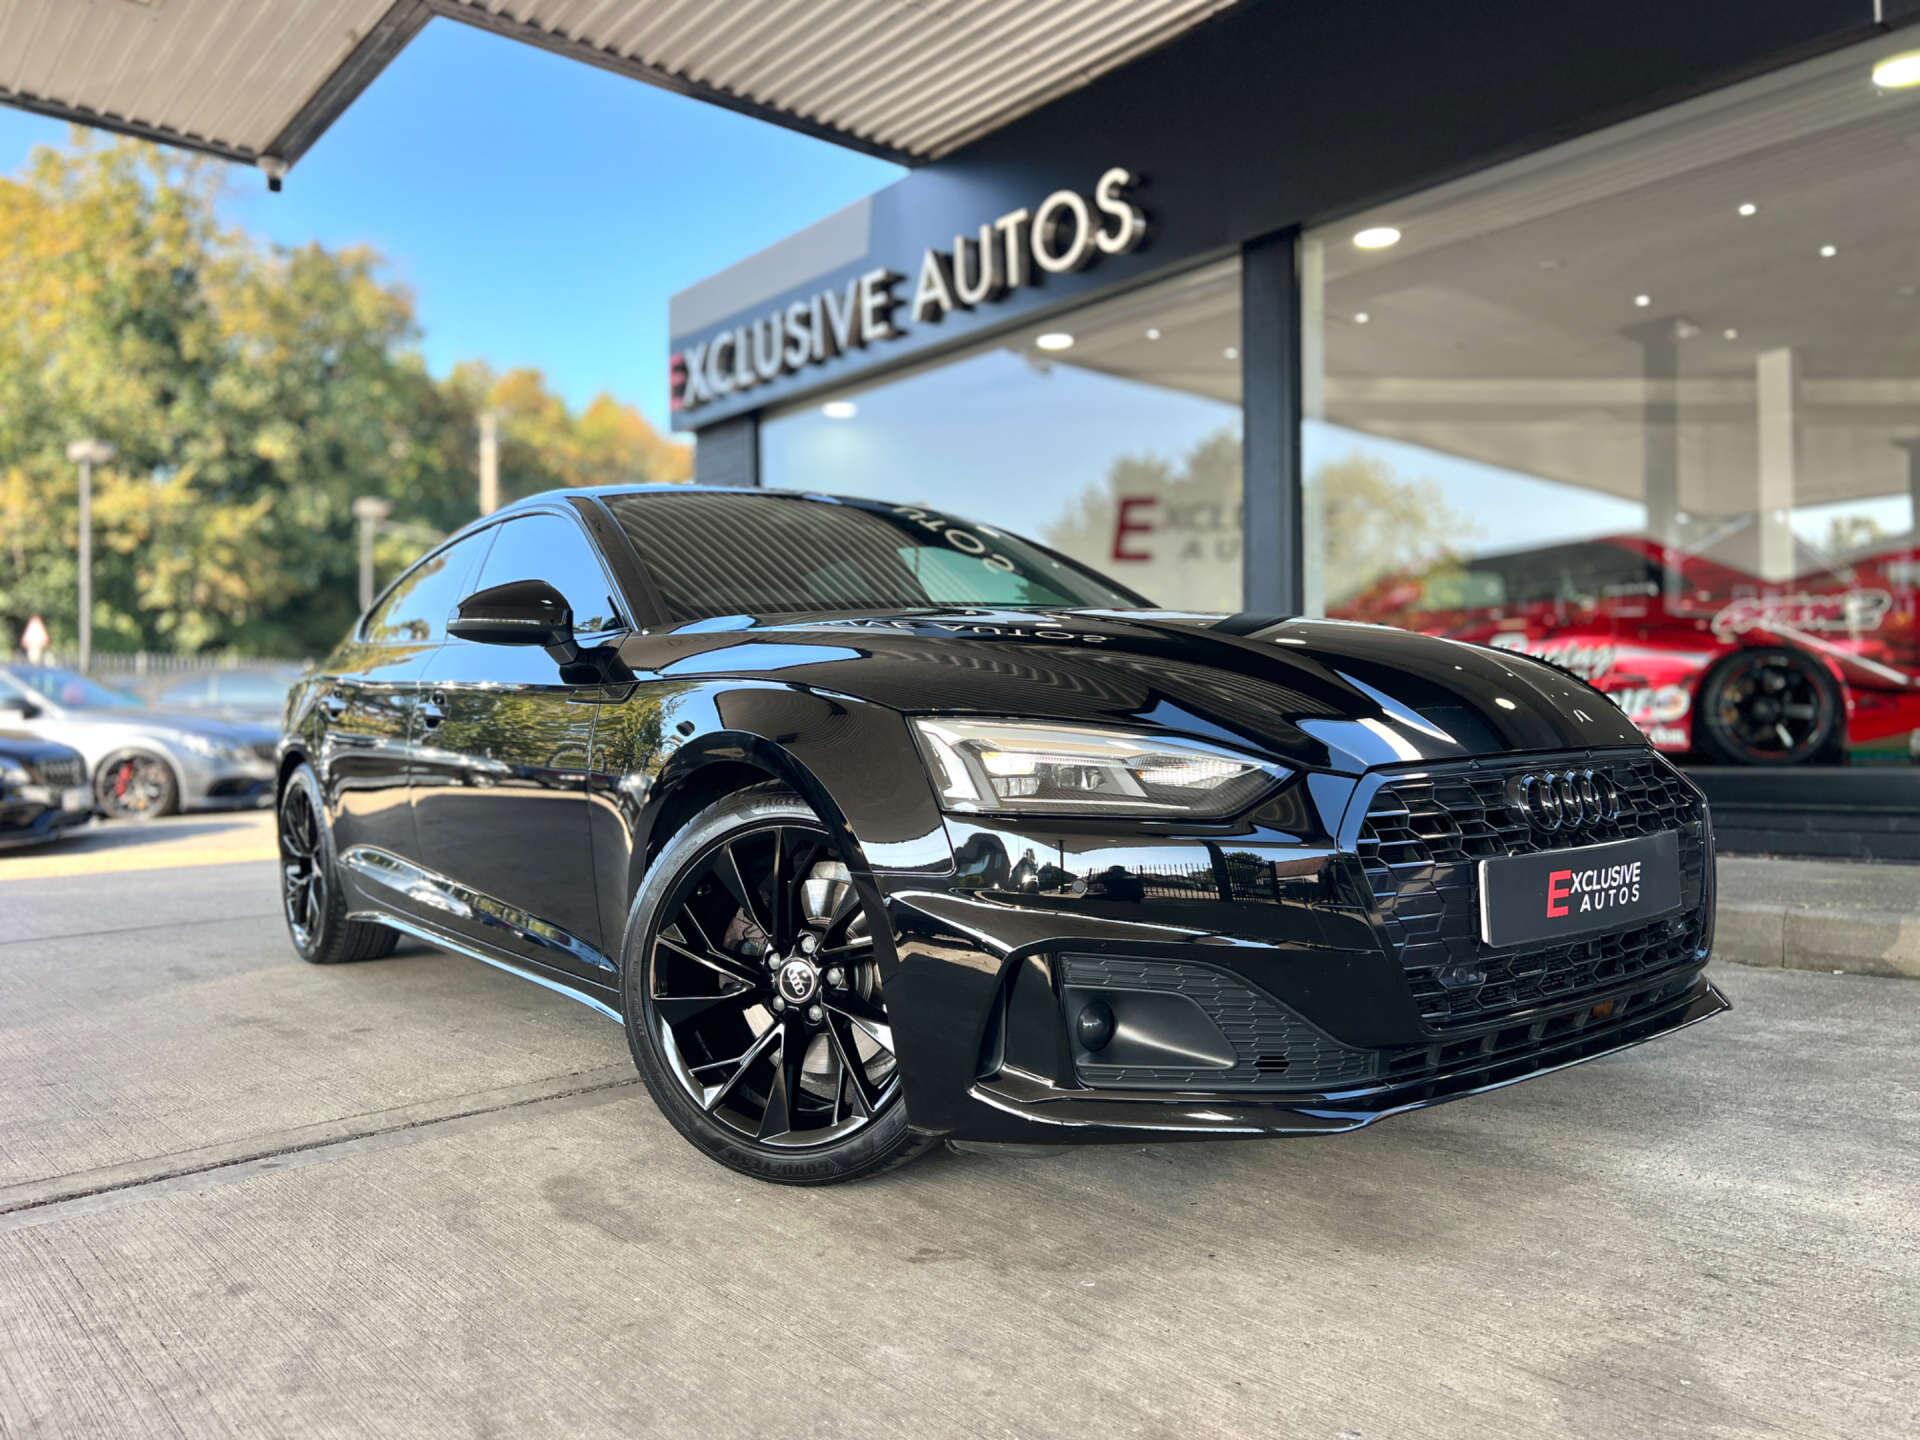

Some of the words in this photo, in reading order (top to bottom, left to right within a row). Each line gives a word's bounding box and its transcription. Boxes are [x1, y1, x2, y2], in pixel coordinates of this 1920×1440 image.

[670, 267, 892, 411] EXCLUSIVE
[911, 166, 1142, 323] AUTOS
[1546, 861, 1641, 918] EXCLUSIVE
[1580, 884, 1640, 912] AUTOS
